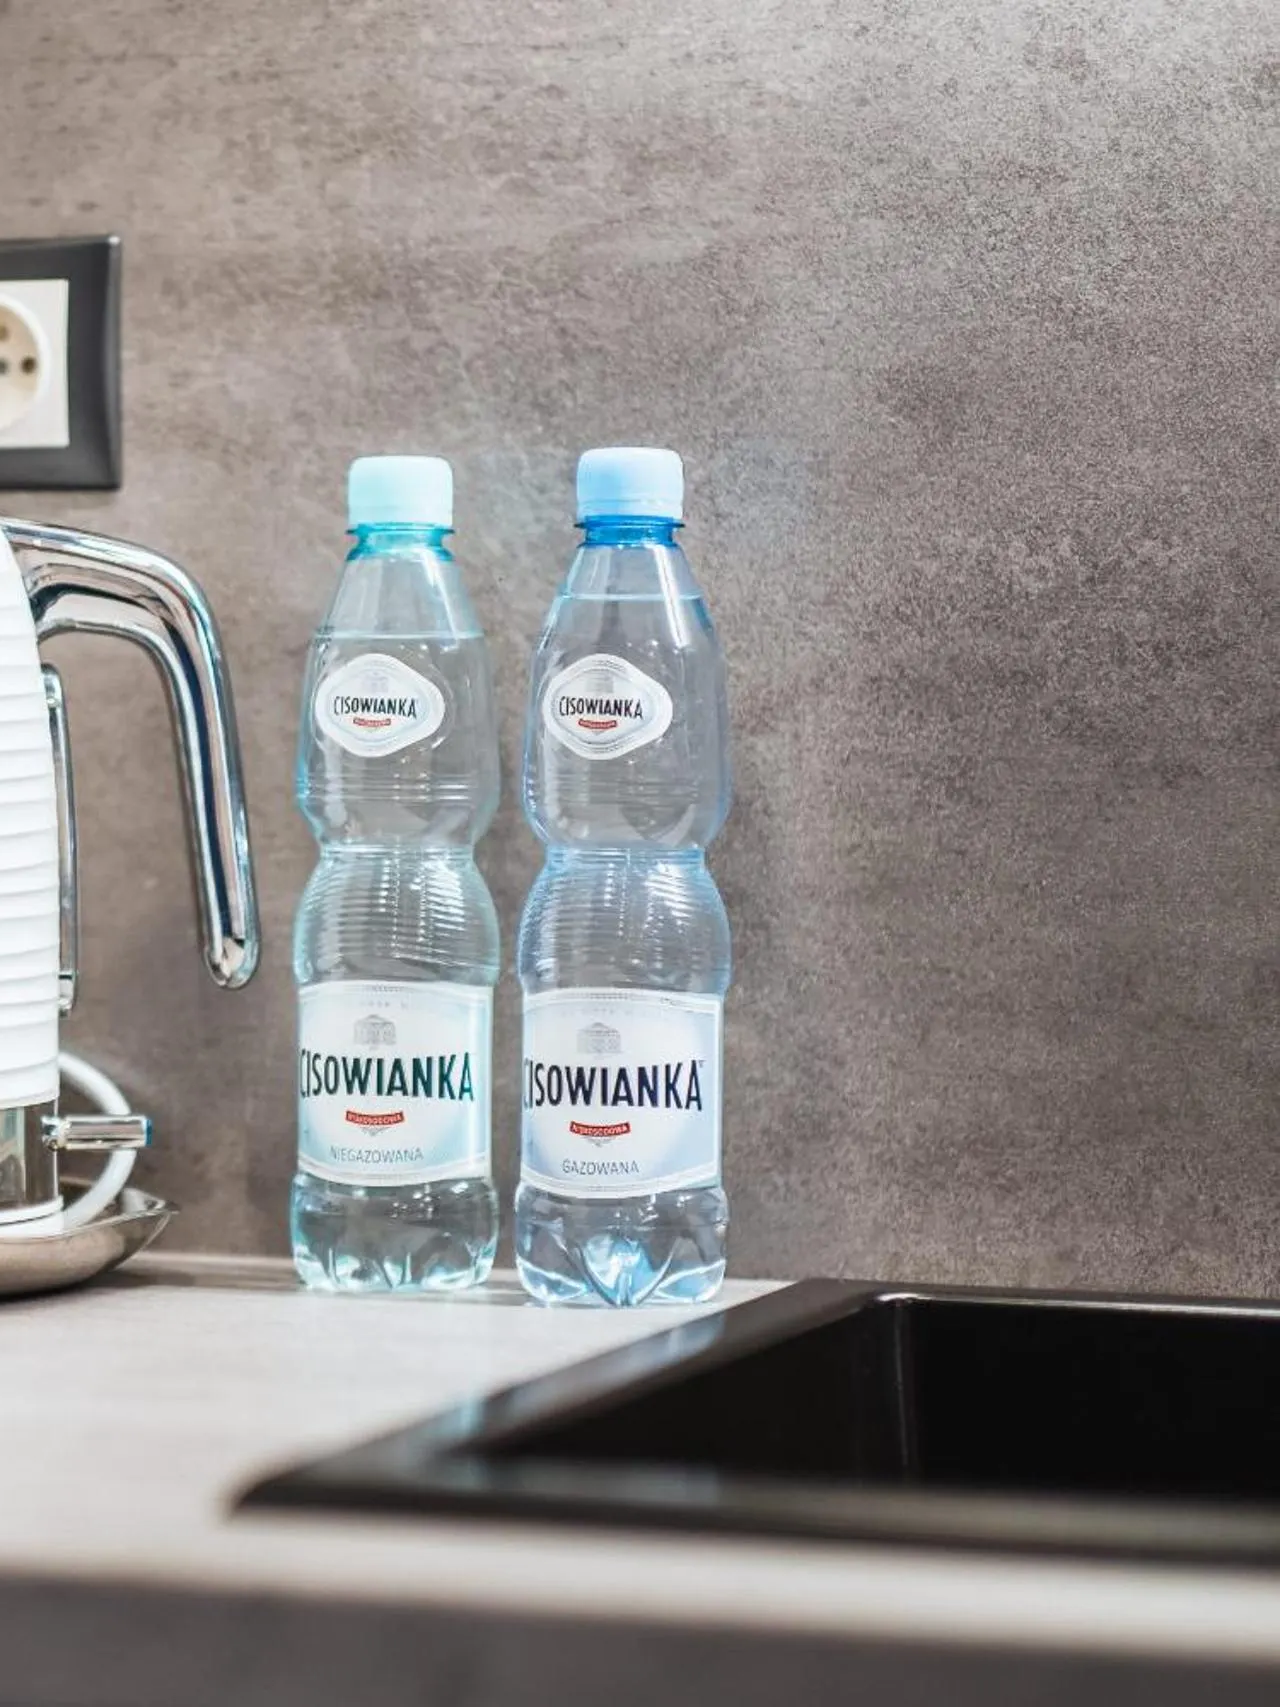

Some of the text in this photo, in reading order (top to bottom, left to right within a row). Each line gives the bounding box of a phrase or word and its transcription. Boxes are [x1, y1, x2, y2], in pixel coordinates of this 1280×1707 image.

[333, 695, 417, 719] CISOWIANKA
[559, 695, 643, 720] CISOWIANKA
[329, 1145, 424, 1164] NIEGAZOWANA
[561, 1158, 640, 1176] GAZOWANA
